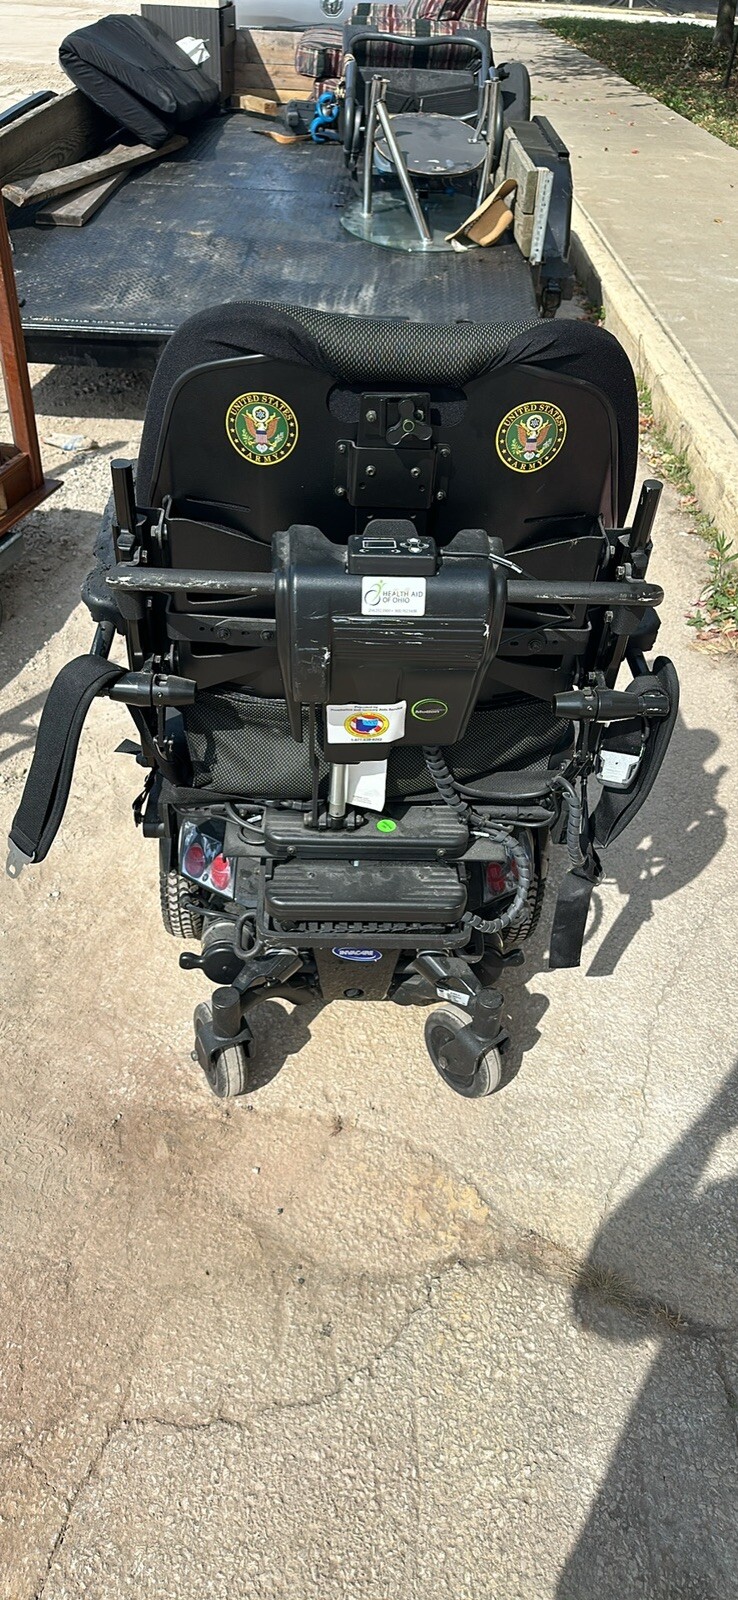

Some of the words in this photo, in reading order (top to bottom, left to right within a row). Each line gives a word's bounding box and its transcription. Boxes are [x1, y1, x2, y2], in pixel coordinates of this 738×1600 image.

[230, 395, 260, 416] UNITED
[261, 395, 293, 421] STATES
[503, 404, 537, 427] UNITED
[538, 404, 564, 427] STATES
[246, 452, 279, 463] ARMY
[511, 458, 543, 470] ARMY
[382, 590, 409, 598] HEALTH
[411, 590, 424, 598] AID
